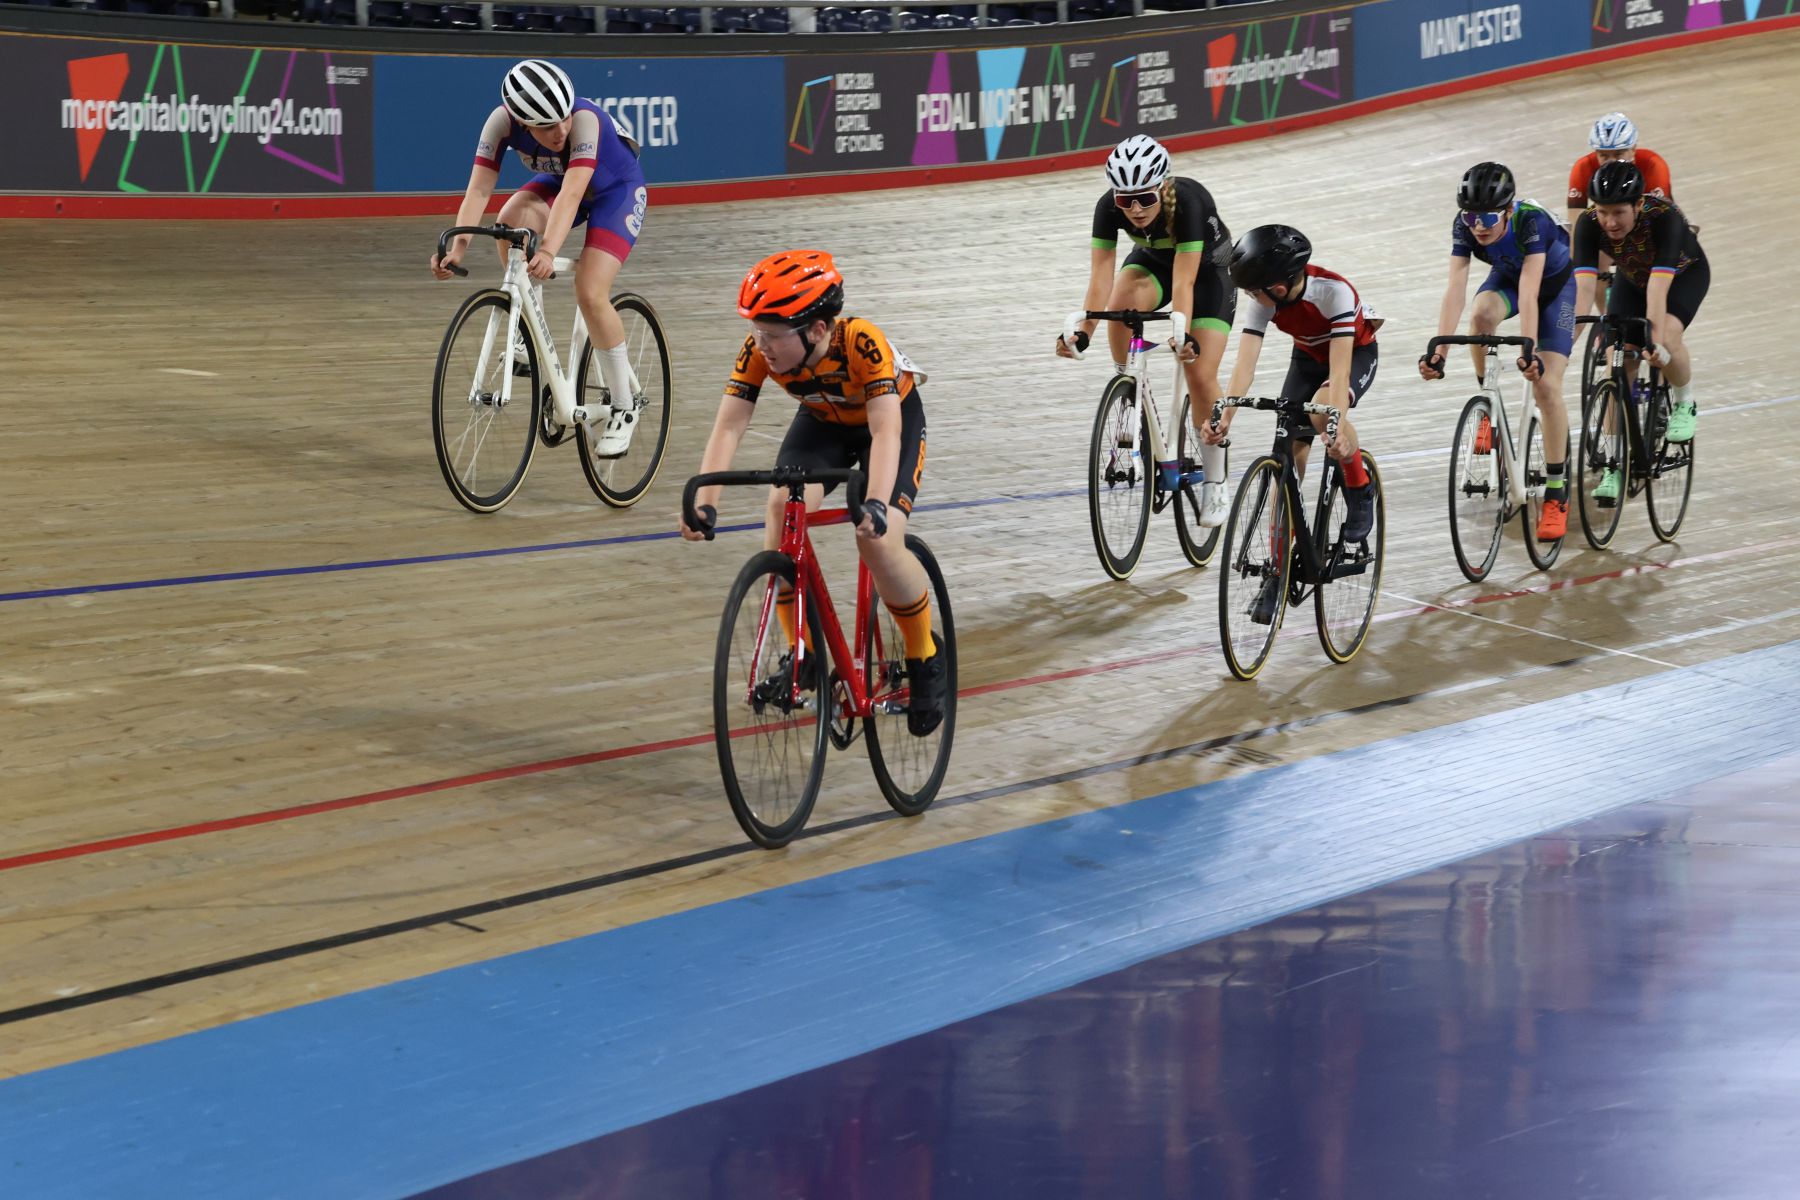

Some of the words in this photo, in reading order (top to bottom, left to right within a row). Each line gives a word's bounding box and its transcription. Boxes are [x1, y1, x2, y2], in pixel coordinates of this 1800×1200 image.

[1420, 4, 1522, 59] MANCHESTER
[61, 93, 343, 145] mcrcapitalofcycling24.com
[835, 92, 881, 111] EUROPEAN
[916, 92, 976, 133] PEDAL
[978, 86, 1031, 129] MORE
[1032, 85, 1050, 123] IN
[855, 331, 883, 364] CSP
